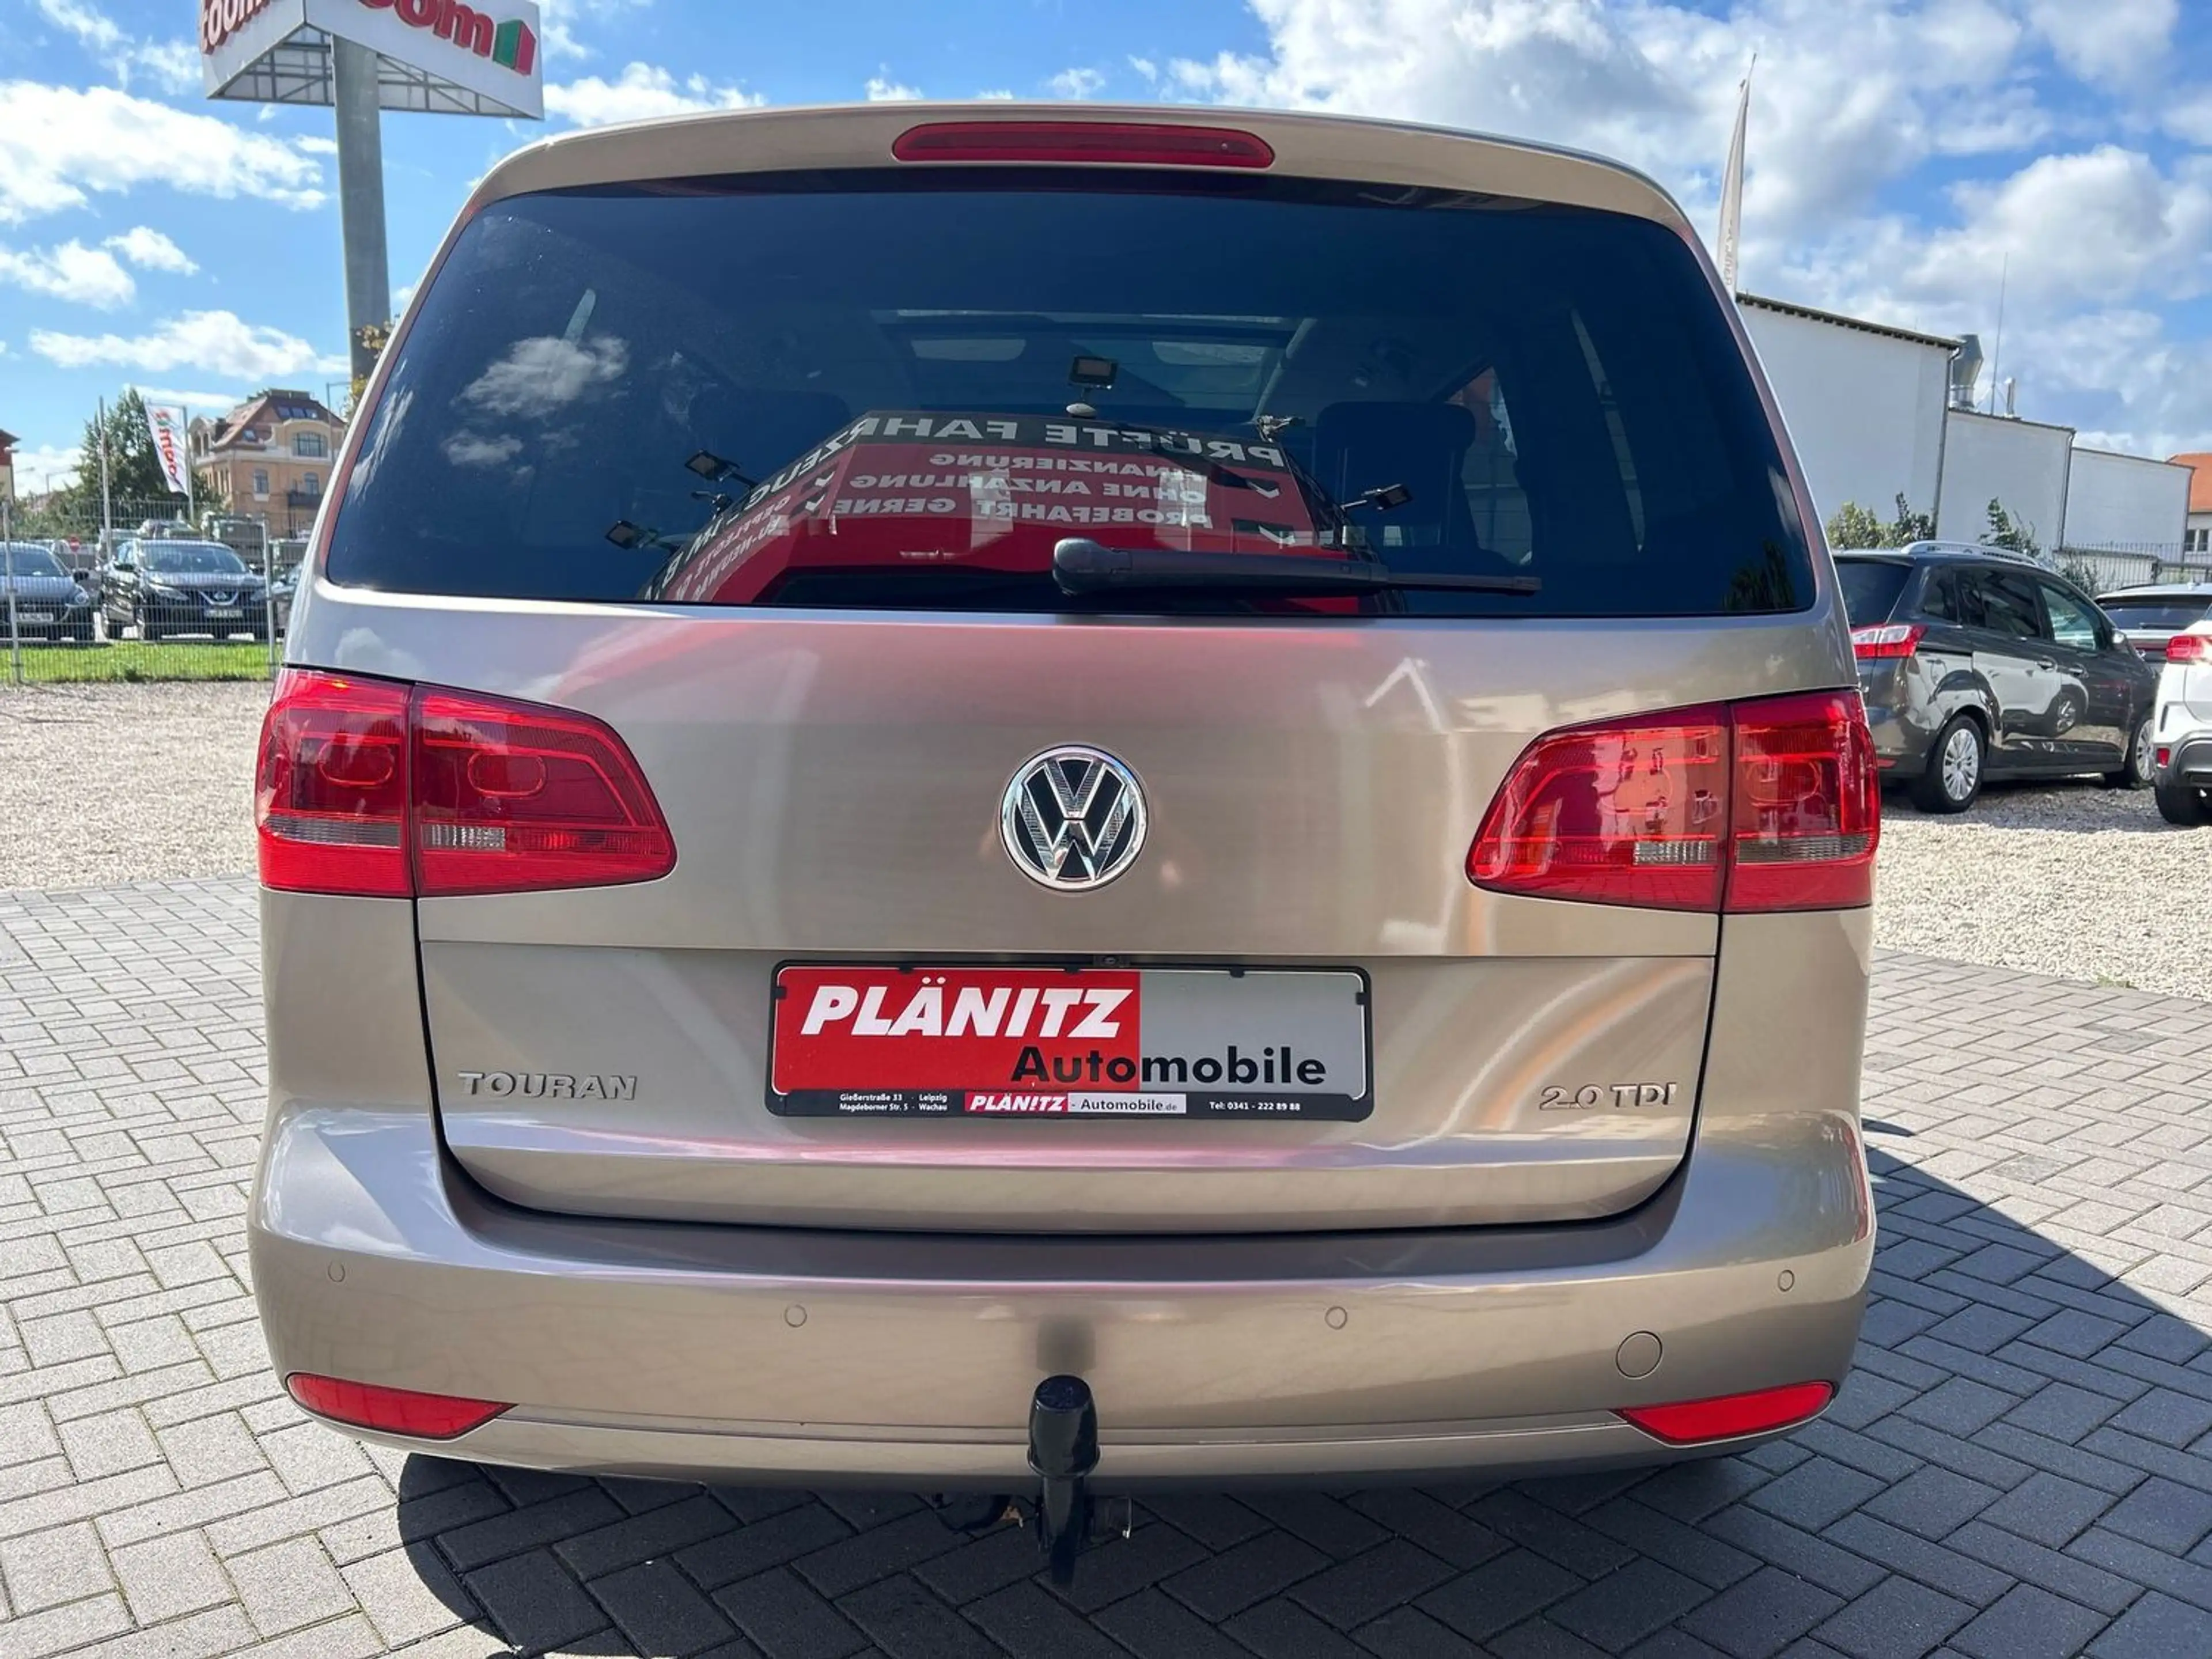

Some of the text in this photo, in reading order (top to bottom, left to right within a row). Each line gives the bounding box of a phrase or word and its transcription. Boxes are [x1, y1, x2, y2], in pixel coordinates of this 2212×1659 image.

[354, 0, 494, 58] om
[801, 976, 1133, 1037] PLÄNITZ
[1011, 1046, 1326, 1085] Automobile
[458, 1070, 637, 1101] TOURAN
[839, 1093, 891, 1101] Gießerstraße
[892, 1093, 903, 1101] 33
[919, 1093, 948, 1103] Leipzig
[1539, 1081, 1677, 1111] 2.0 TDI
[839, 1103, 888, 1112] Magdeborner
[889, 1103, 902, 1111] Str.
[918, 1103, 948, 1111] Wachau
[970, 1093, 1067, 1112] PLÄNITZ
[1227, 1101, 1249, 1110] 0341
[1257, 1102, 1274, 1111] 222
[1276, 1103, 1288, 1111] 89
